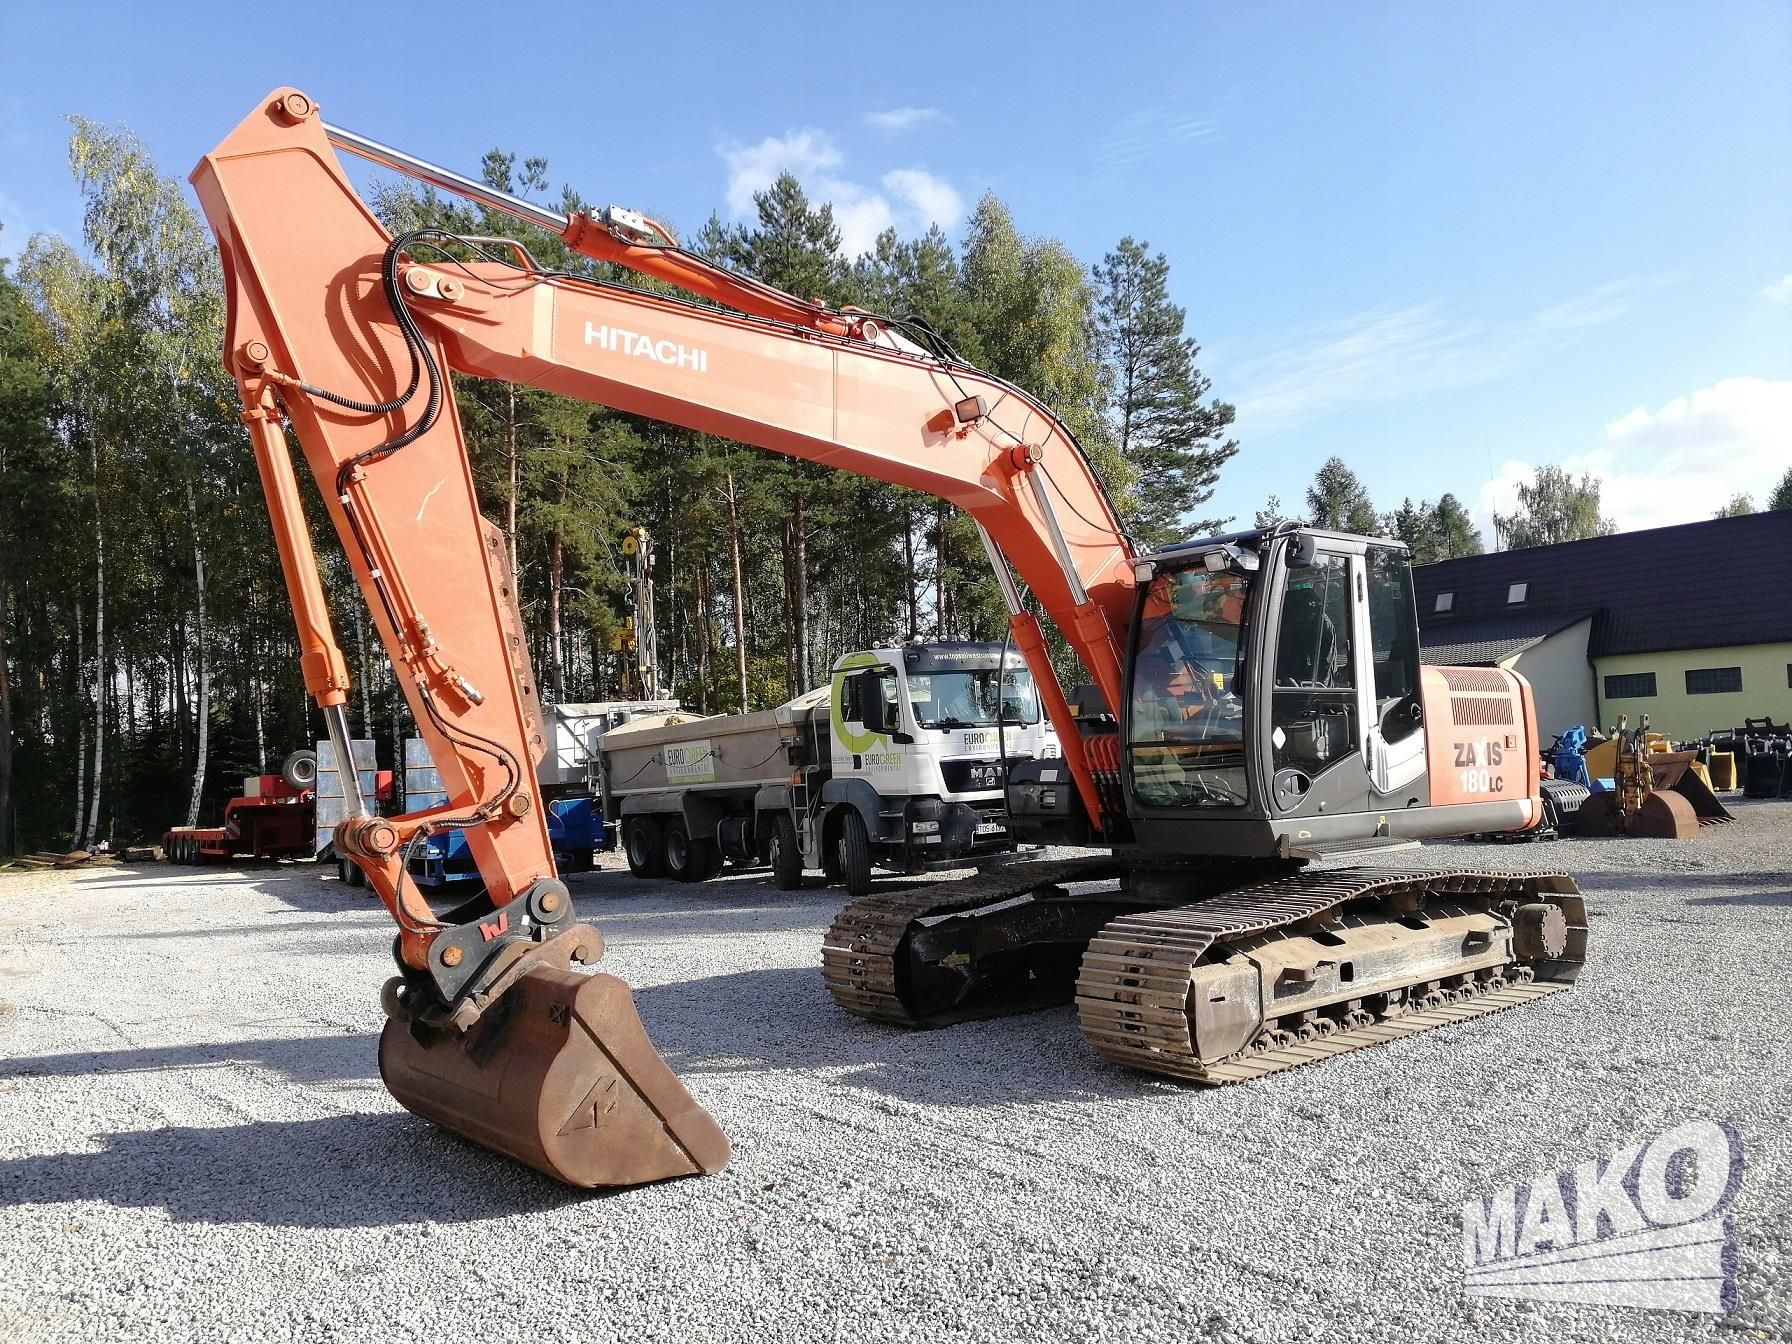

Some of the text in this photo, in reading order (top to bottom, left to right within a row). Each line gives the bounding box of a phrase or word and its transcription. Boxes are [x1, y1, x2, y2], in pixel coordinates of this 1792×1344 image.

[584, 320, 707, 373] HITACHI
[865, 752, 902, 765] EUROGREEN
[1454, 735, 1502, 767] ZAXIS
